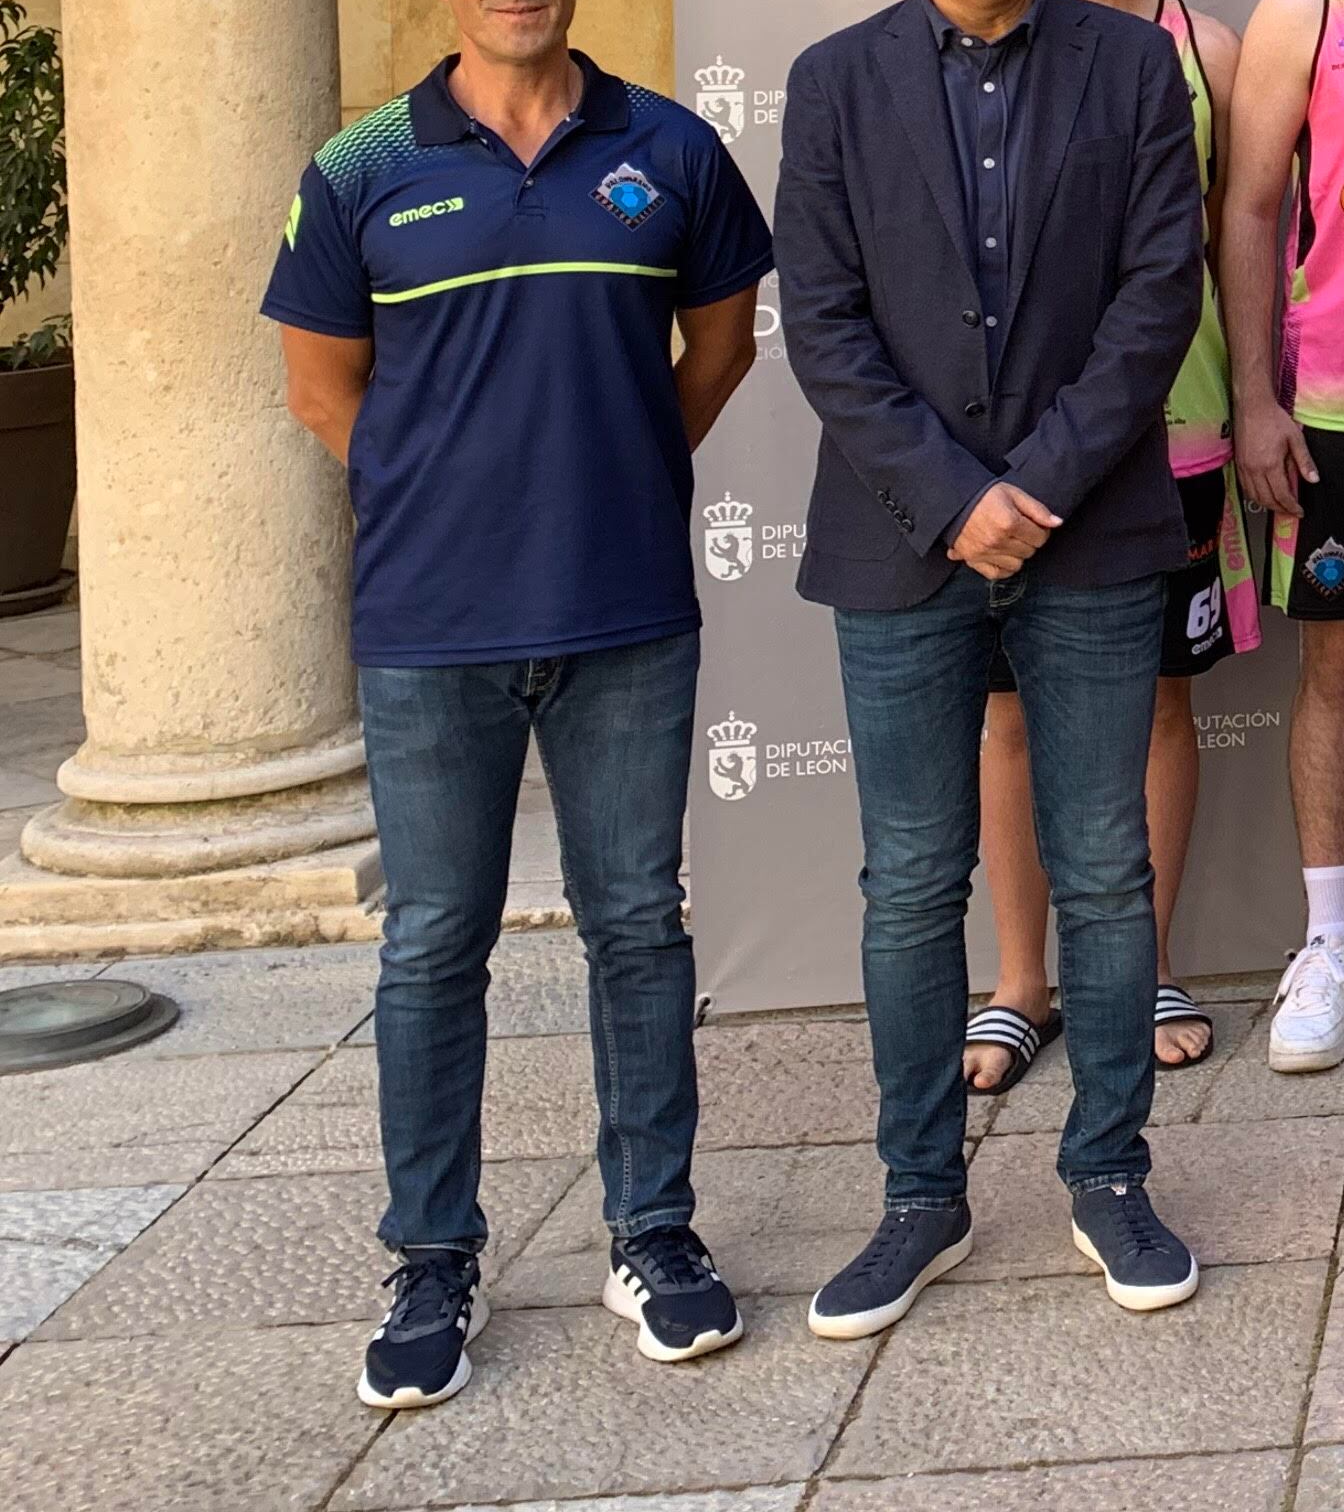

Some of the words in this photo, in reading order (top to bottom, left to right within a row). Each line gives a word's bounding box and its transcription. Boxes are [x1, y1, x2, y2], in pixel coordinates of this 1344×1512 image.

[754, 109, 779, 124] DE
[389, 201, 448, 227] emec
[762, 524, 806, 540] DIPU
[762, 543, 787, 559] DE
[1186, 576, 1221, 639] 69
[1197, 729, 1245, 749] LEÓN
[766, 762, 791, 778] DE
[796, 755, 847, 776] LEÓN
